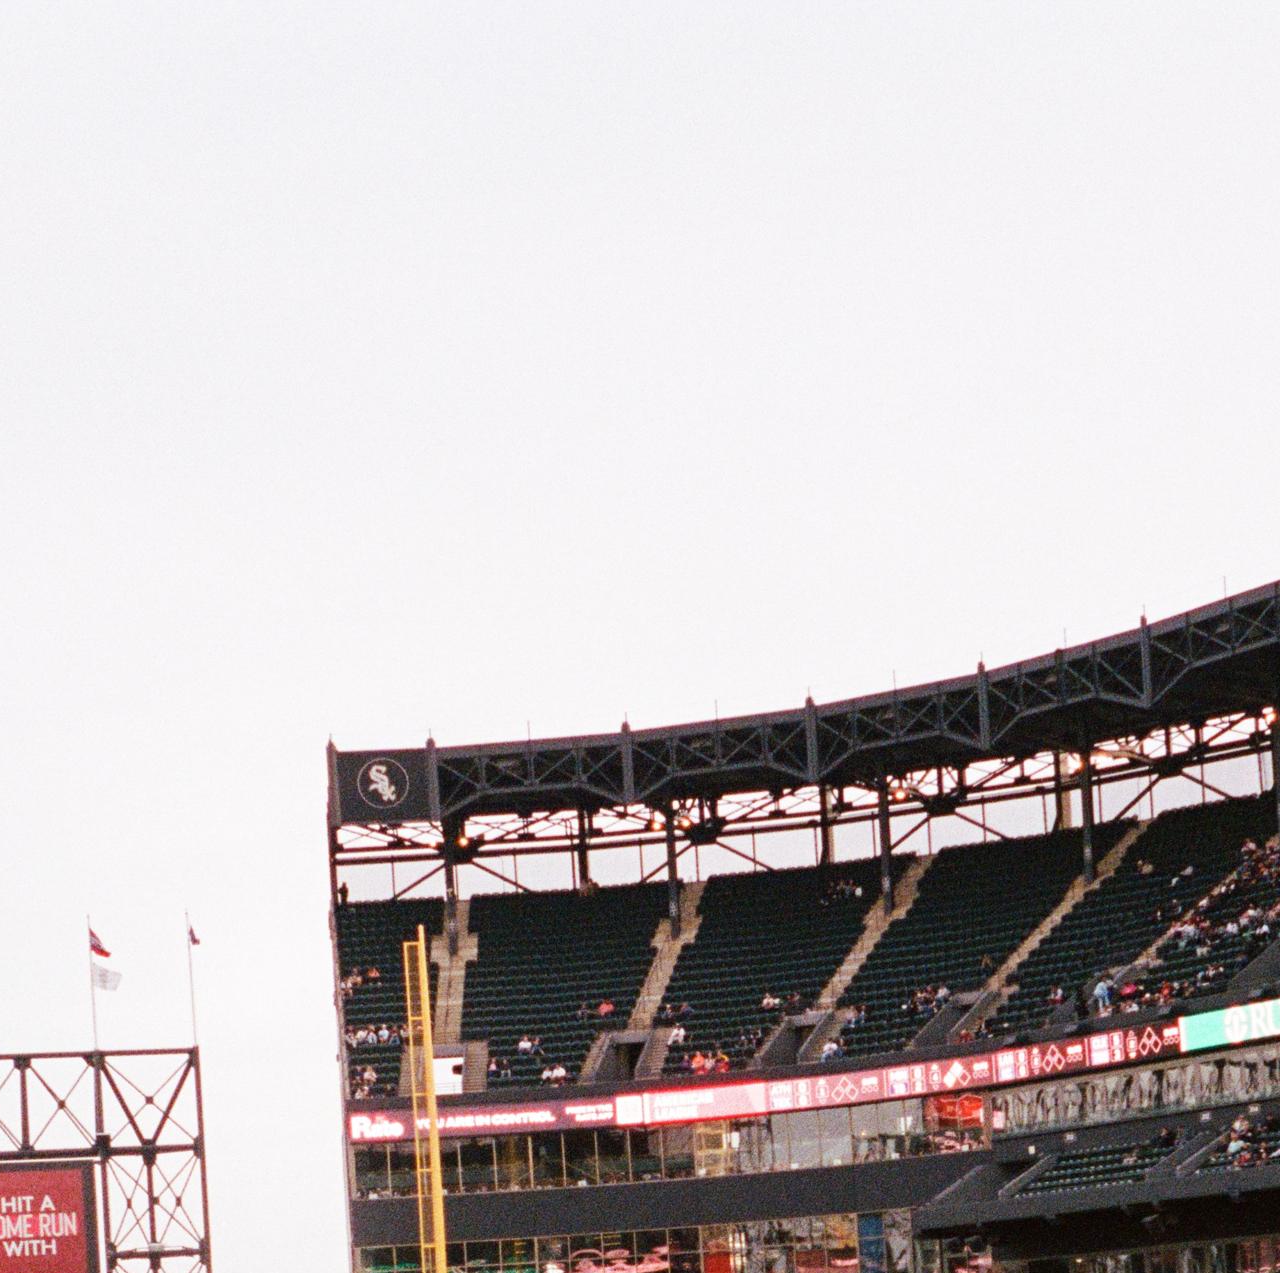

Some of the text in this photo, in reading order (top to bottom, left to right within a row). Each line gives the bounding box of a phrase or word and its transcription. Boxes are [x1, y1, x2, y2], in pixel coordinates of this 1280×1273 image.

[351, 1112, 405, 1141] Rate
[491, 1110, 557, 1127] CONTROL
[0, 1194, 57, 1214] HIT A
[38, 1211, 79, 1238] RUN
[2, 1239, 58, 1258] WITH
